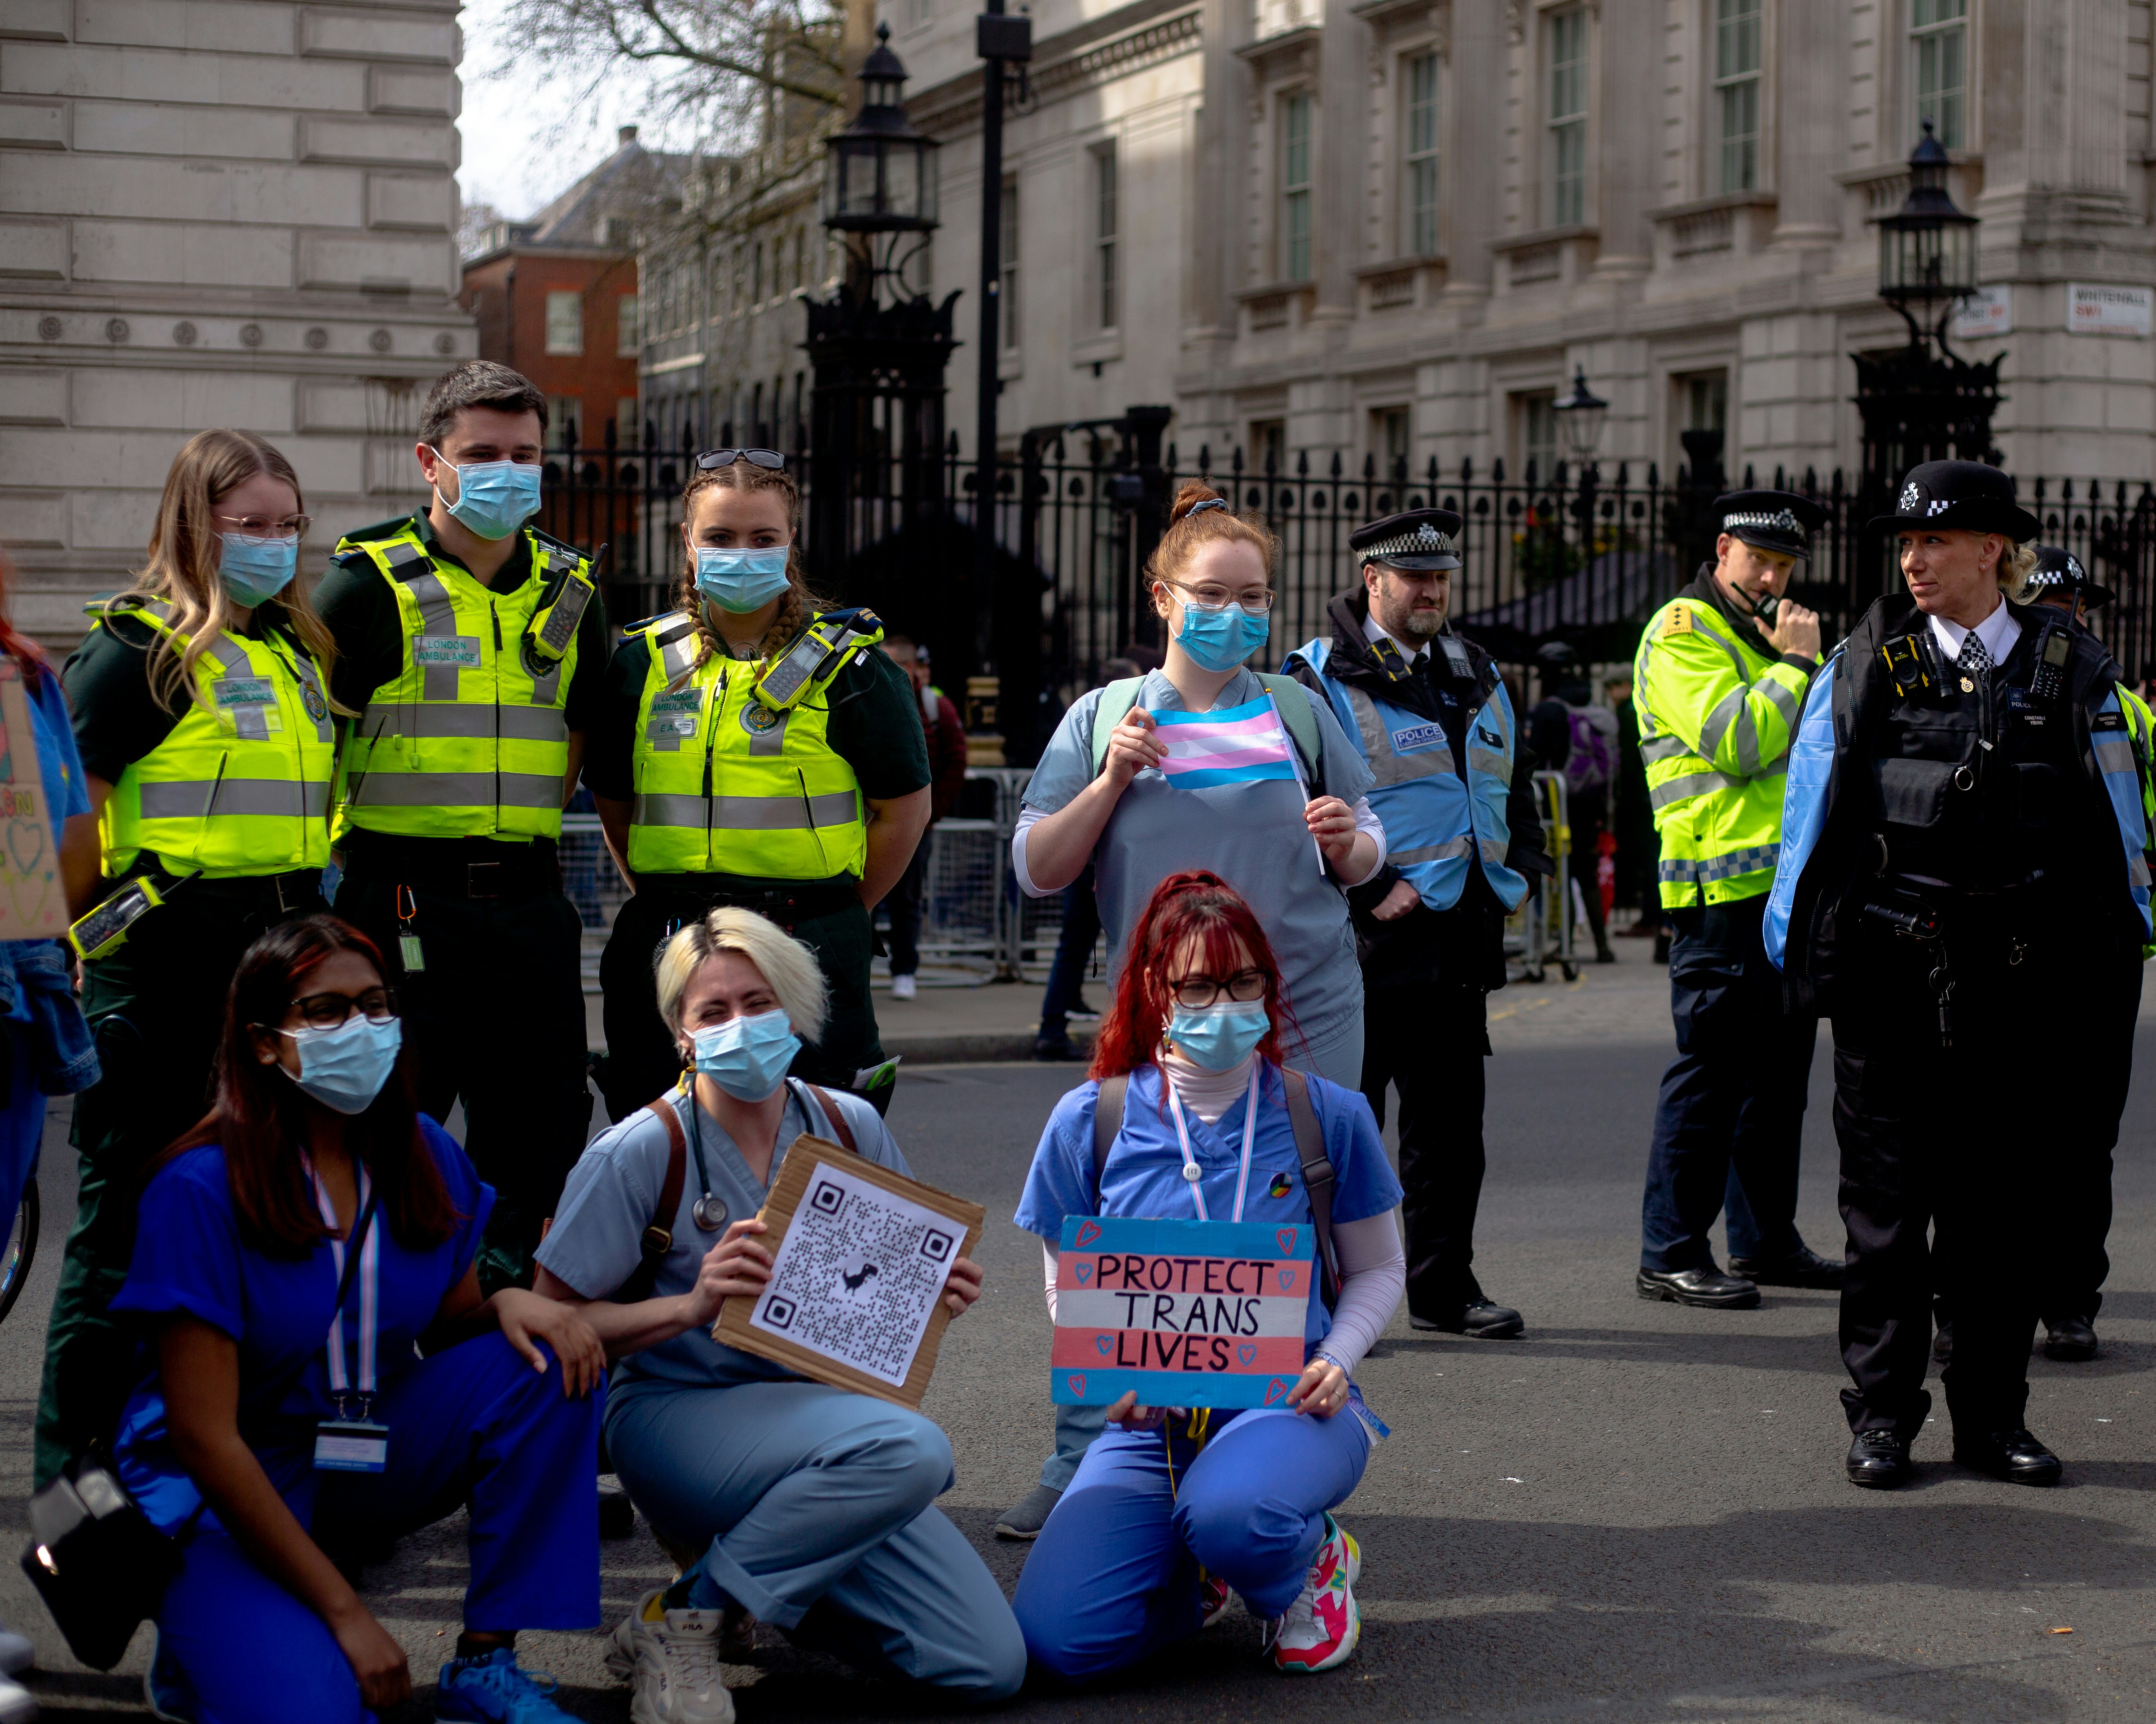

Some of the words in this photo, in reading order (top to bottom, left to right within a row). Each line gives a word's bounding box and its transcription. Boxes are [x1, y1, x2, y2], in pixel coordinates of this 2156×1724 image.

[2076, 289, 2145, 306] WHITEHALL
[427, 640, 466, 650] LONDON
[419, 651, 475, 662] AMBULANCE
[226, 682, 261, 692] LONDON
[220, 692, 273, 704] AMBULANCE
[661, 693, 694, 702] LONDON
[652, 701, 698, 712] AMBULANCE
[1397, 726, 1441, 743] POLICE
[1399, 739, 1421, 748] LIAISON
[1097, 1255, 1274, 1295] PROTECT
[1115, 1292, 1261, 1336] TRANS
[1117, 1332, 1230, 1371] LIVES
[659, 1672, 667, 1691] FILA
